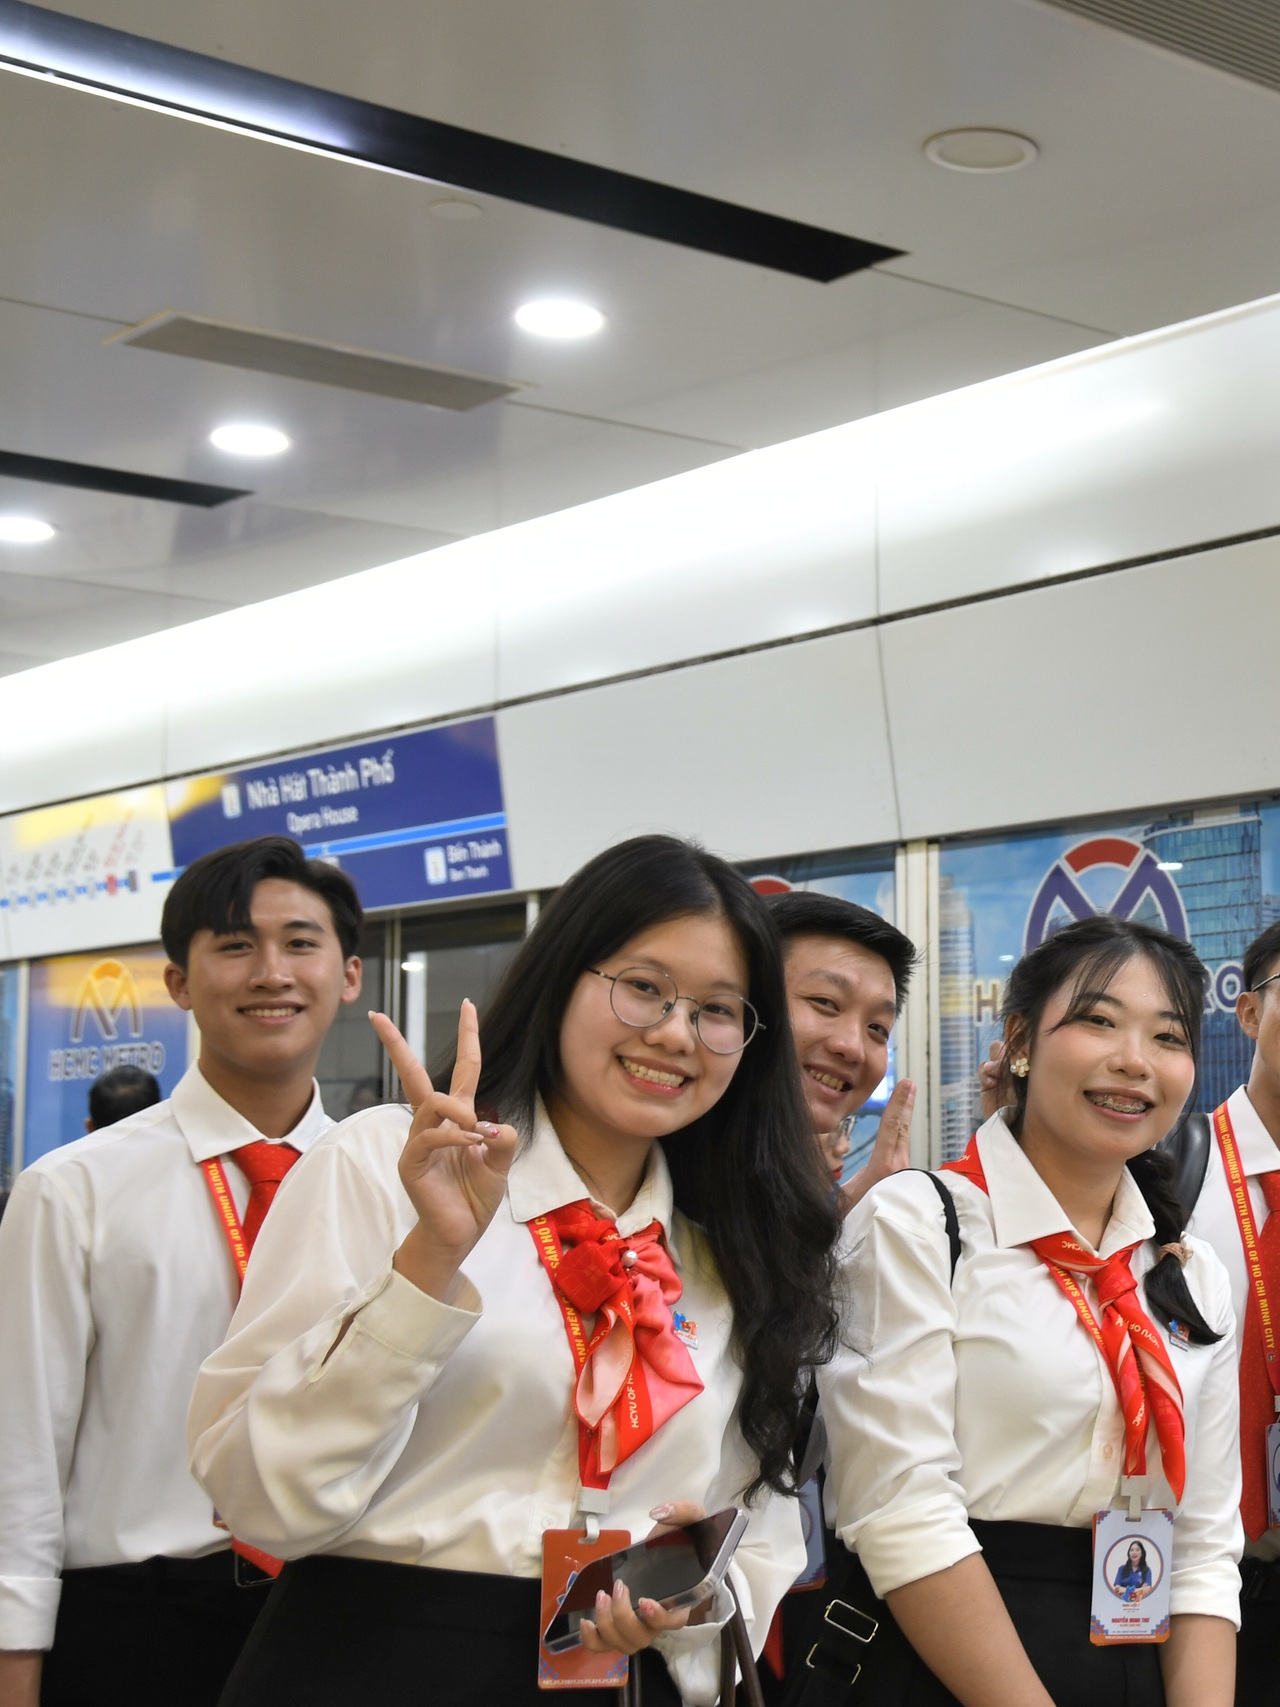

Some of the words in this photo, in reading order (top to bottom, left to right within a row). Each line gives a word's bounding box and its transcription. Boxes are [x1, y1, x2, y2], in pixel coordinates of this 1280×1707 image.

[247, 777, 281, 810] Nhà
[306, 761, 360, 798] Thành
[358, 748, 396, 789] Phố
[286, 811, 322, 836] Opera
[321, 804, 360, 829] House
[1221, 1133, 1242, 1184] COMMUNIST
[207, 1163, 226, 1194] YOUTH
[219, 1195, 237, 1227] UNION
[1234, 1186, 1248, 1216] YOUTH
[230, 1228, 242, 1241] OF
[1241, 1218, 1256, 1248] UNION
[234, 1243, 246, 1258] HO
[1248, 1250, 1259, 1262] OF
[1251, 1264, 1262, 1278] HO
[1255, 1280, 1266, 1297] CHI
[1259, 1299, 1272, 1325] MINH
[1264, 1327, 1275, 1349] CITY
[627, 1384, 638, 1402] OF
[627, 1402, 640, 1430] HCYU
